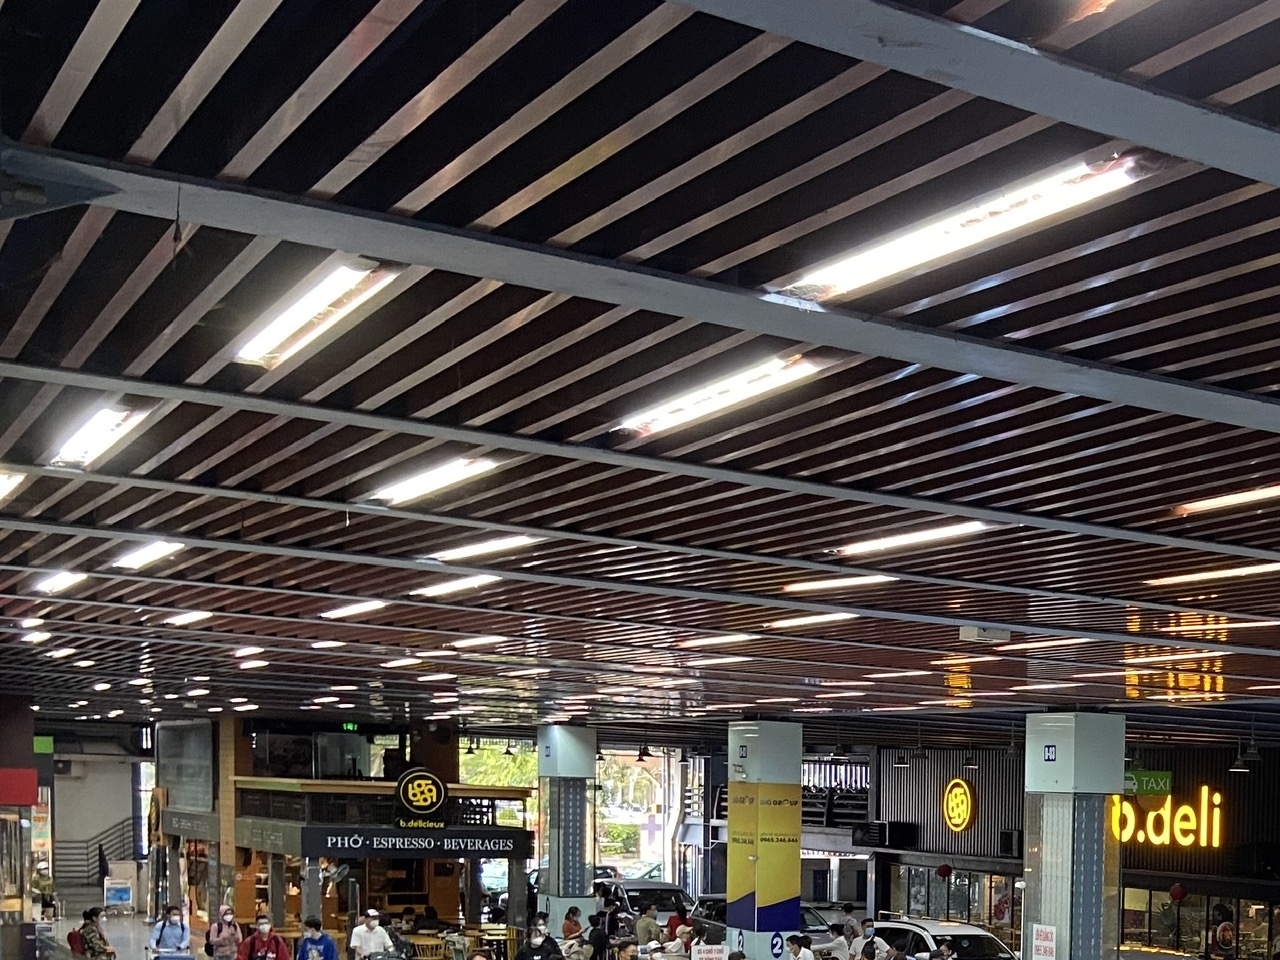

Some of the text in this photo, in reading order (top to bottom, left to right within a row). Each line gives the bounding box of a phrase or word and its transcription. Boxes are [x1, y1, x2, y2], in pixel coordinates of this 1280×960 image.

[1141, 777, 1170, 791] TAXI
[1112, 785, 1221, 848] b.deli
[327, 834, 513, 850] PHỞ ESPRESSO BEVERAGES
[772, 937, 782, 954] 2
